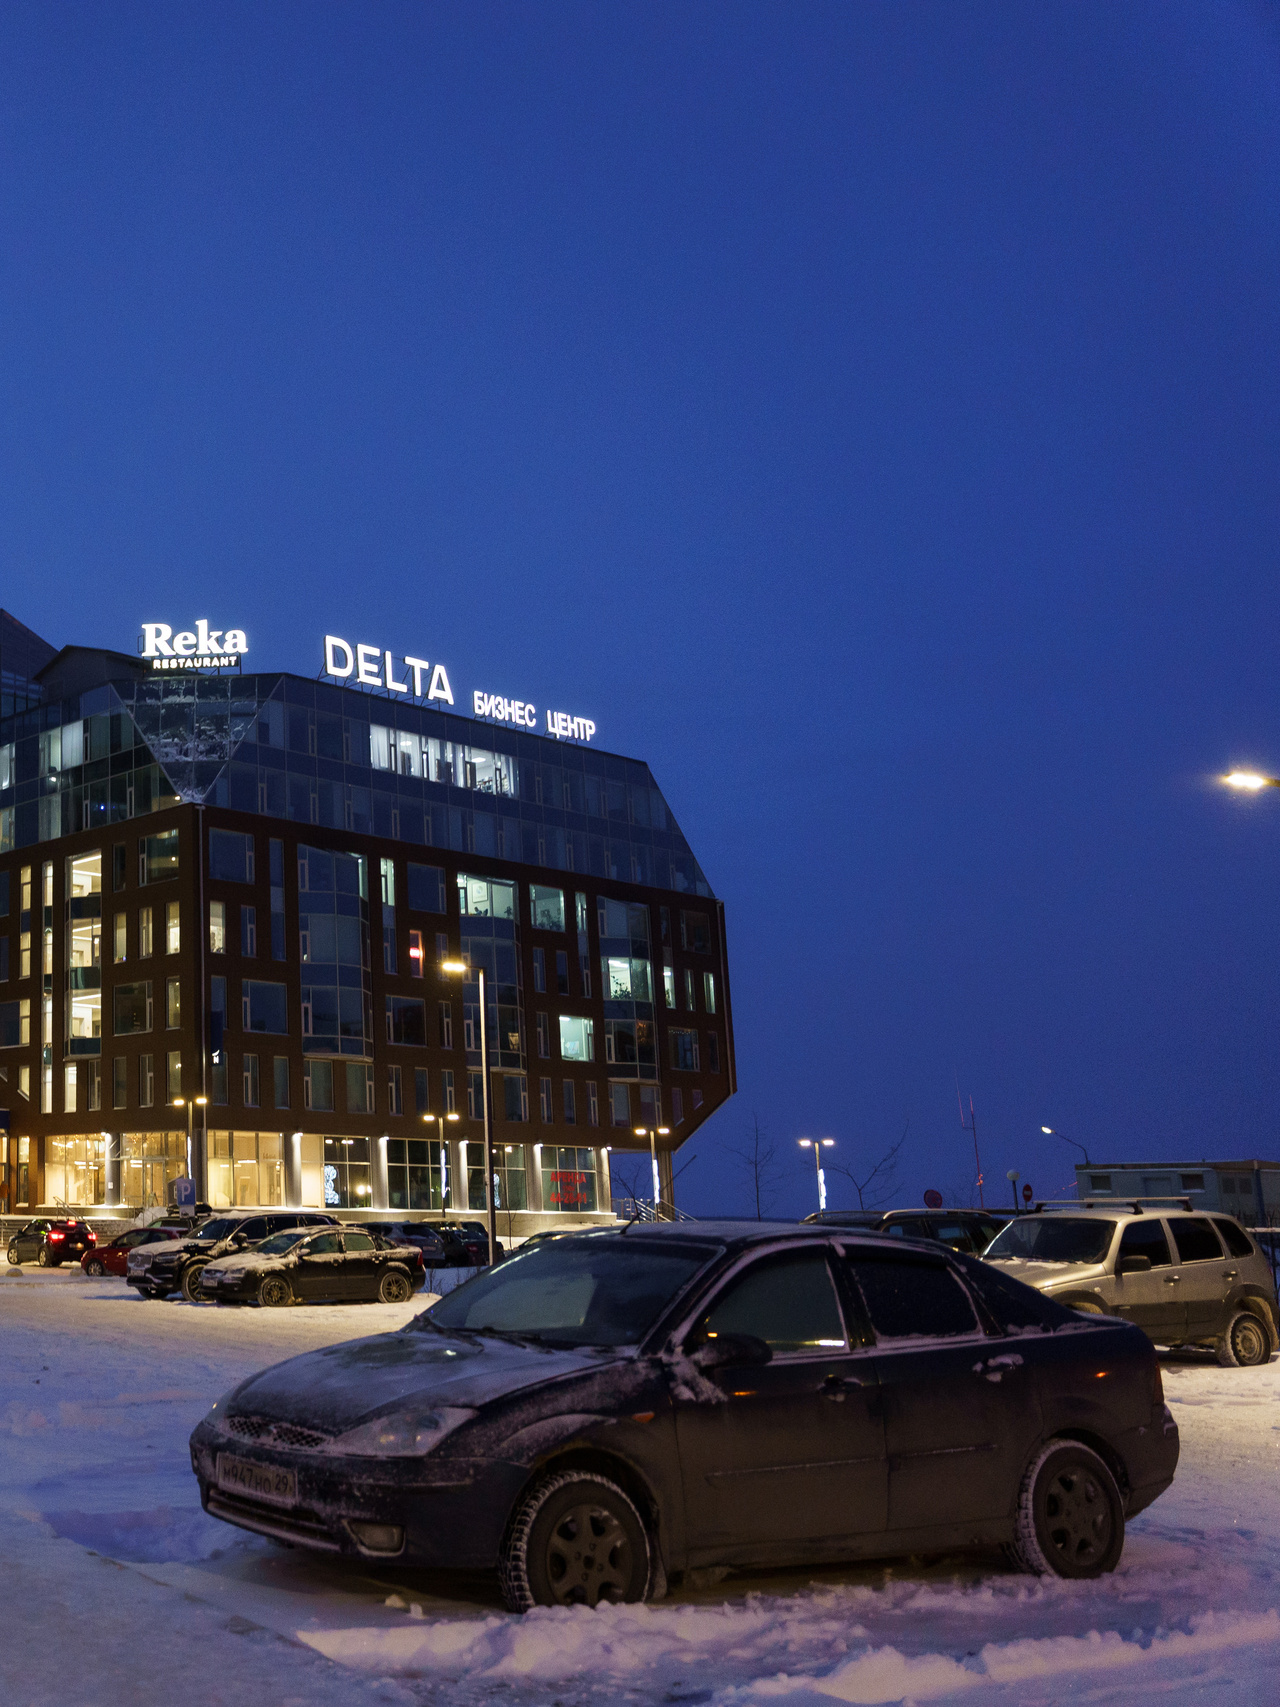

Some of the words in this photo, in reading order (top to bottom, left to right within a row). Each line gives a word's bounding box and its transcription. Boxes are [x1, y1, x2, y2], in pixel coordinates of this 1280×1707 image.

[141, 619, 249, 657] Reka
[152, 656, 238, 669] RESTAURANT
[324, 634, 454, 705] DELTA
[473, 690, 537, 728] БИЗНЕС
[546, 709, 596, 741] ЦЕНТР
